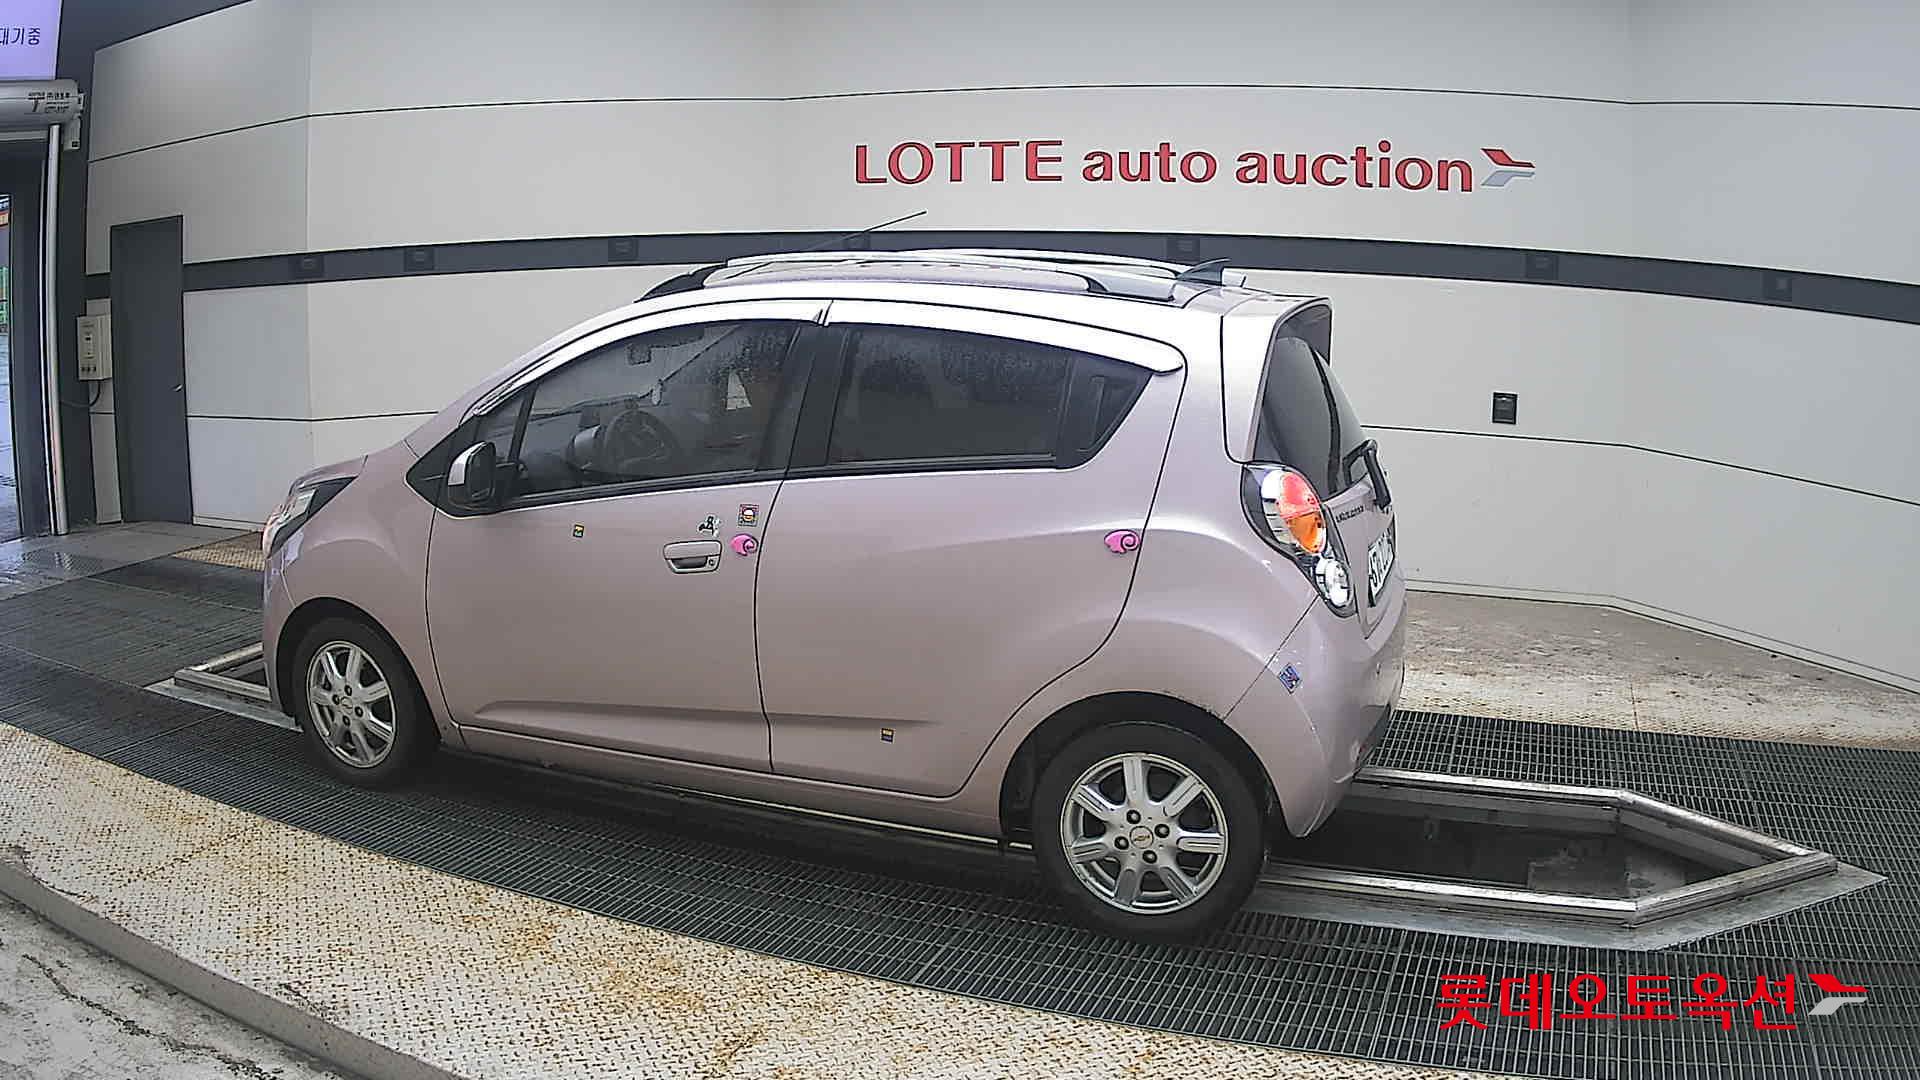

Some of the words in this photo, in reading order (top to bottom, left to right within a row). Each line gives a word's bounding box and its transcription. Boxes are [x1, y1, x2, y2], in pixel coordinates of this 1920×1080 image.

[855, 140, 1063, 184] LOTTE
[1081, 142, 1217, 183] auto
[1236, 140, 1473, 192] auction
